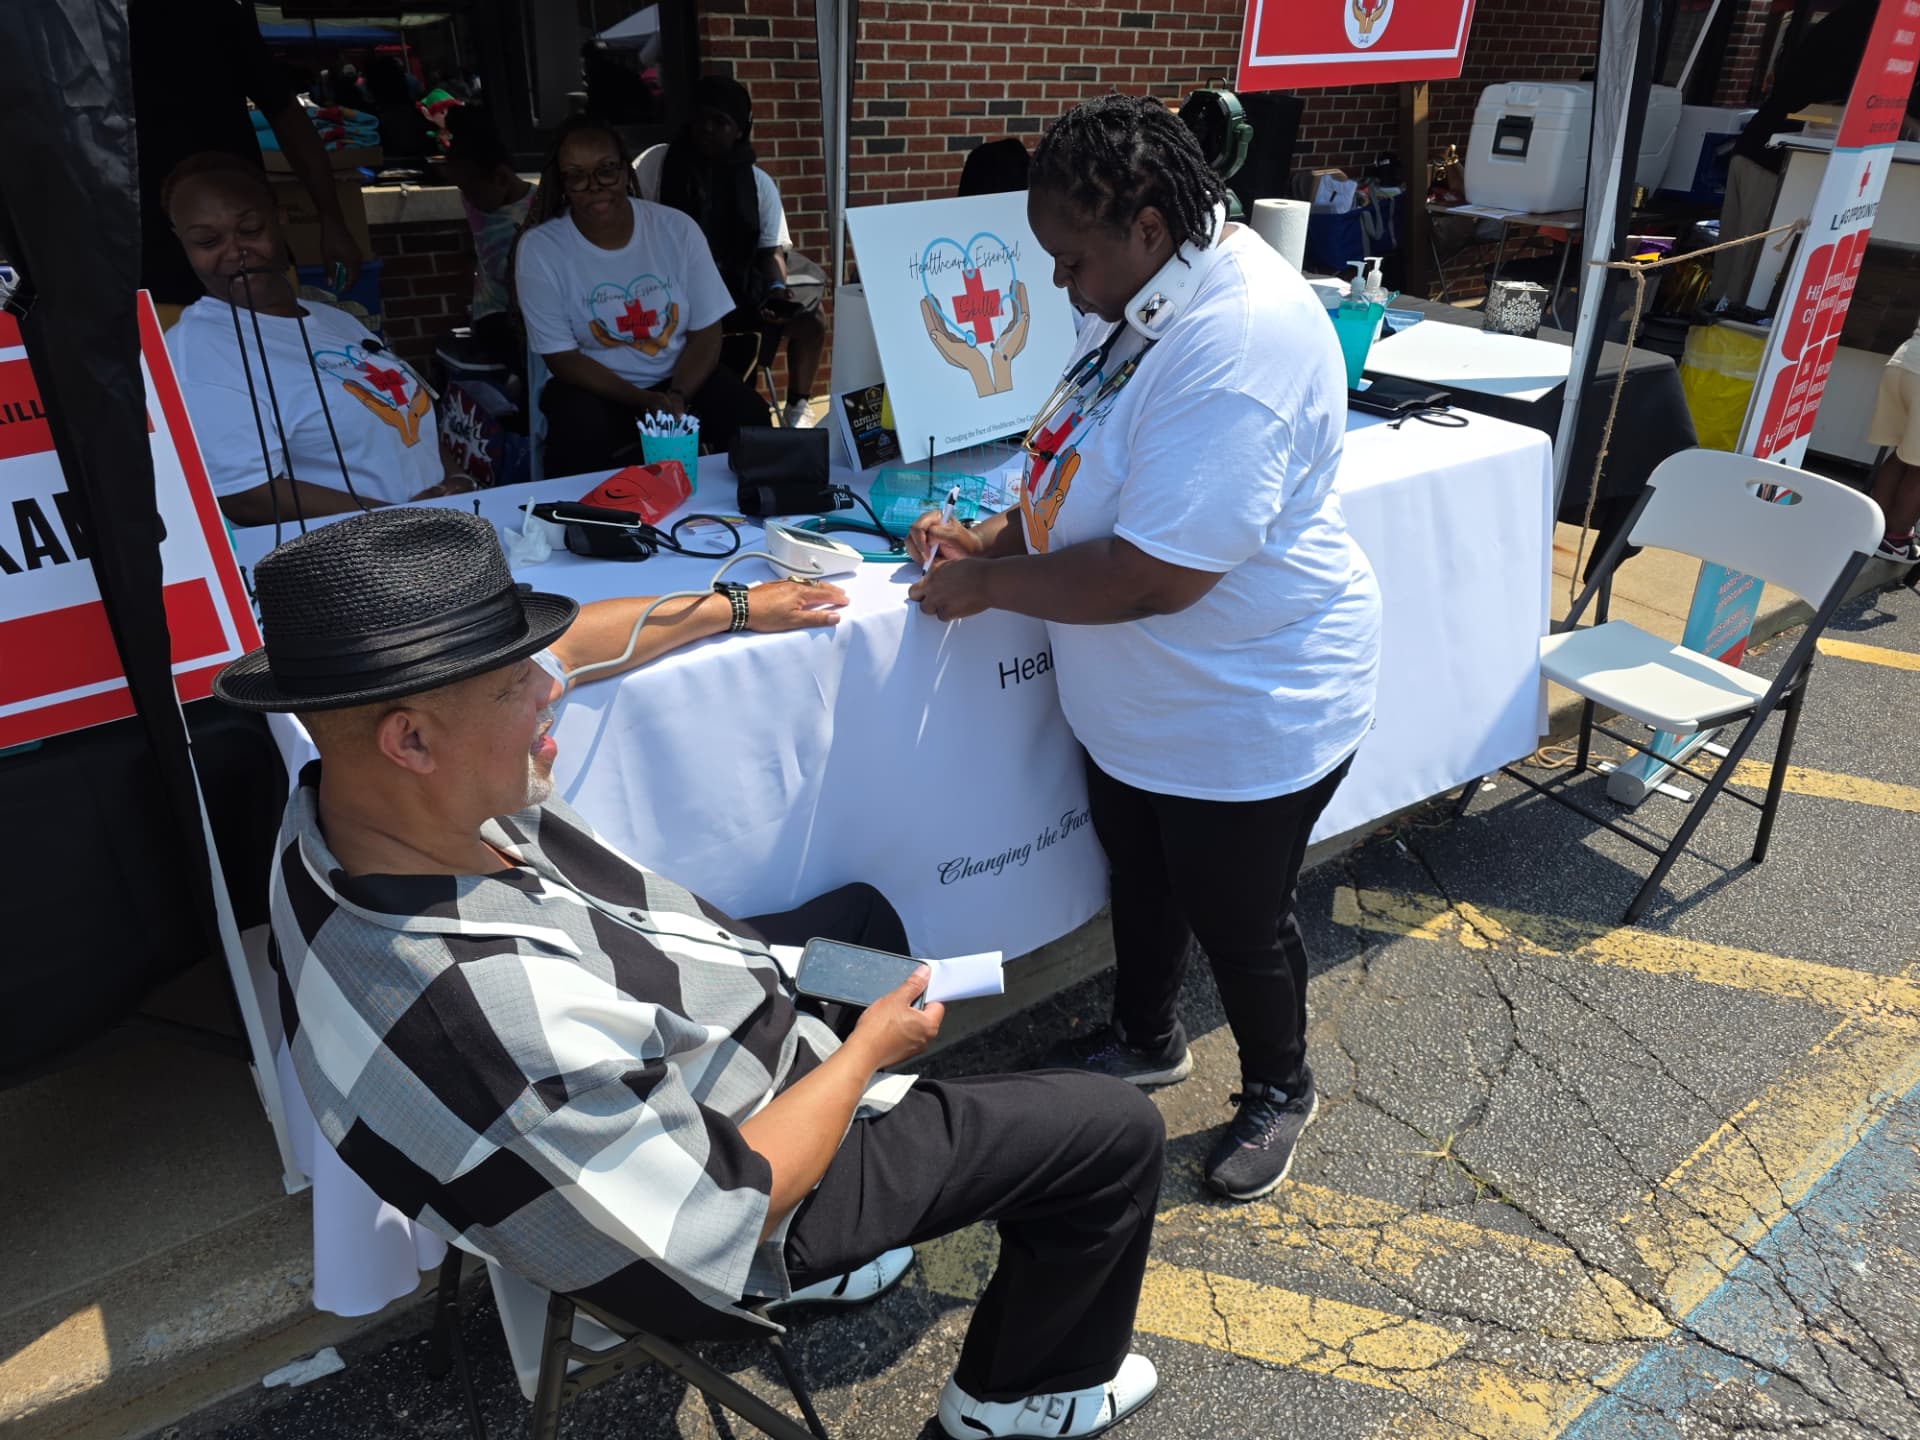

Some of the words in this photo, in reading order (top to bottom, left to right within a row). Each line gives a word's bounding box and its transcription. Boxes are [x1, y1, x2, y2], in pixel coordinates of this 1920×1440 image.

[909, 250, 971, 280] Healthcare
[975, 240, 1022, 270] Essential
[958, 293, 996, 320] Skills
[0, 399, 46, 424] ILL
[937, 842, 1031, 885] Changing
[1036, 826, 1058, 851] the
